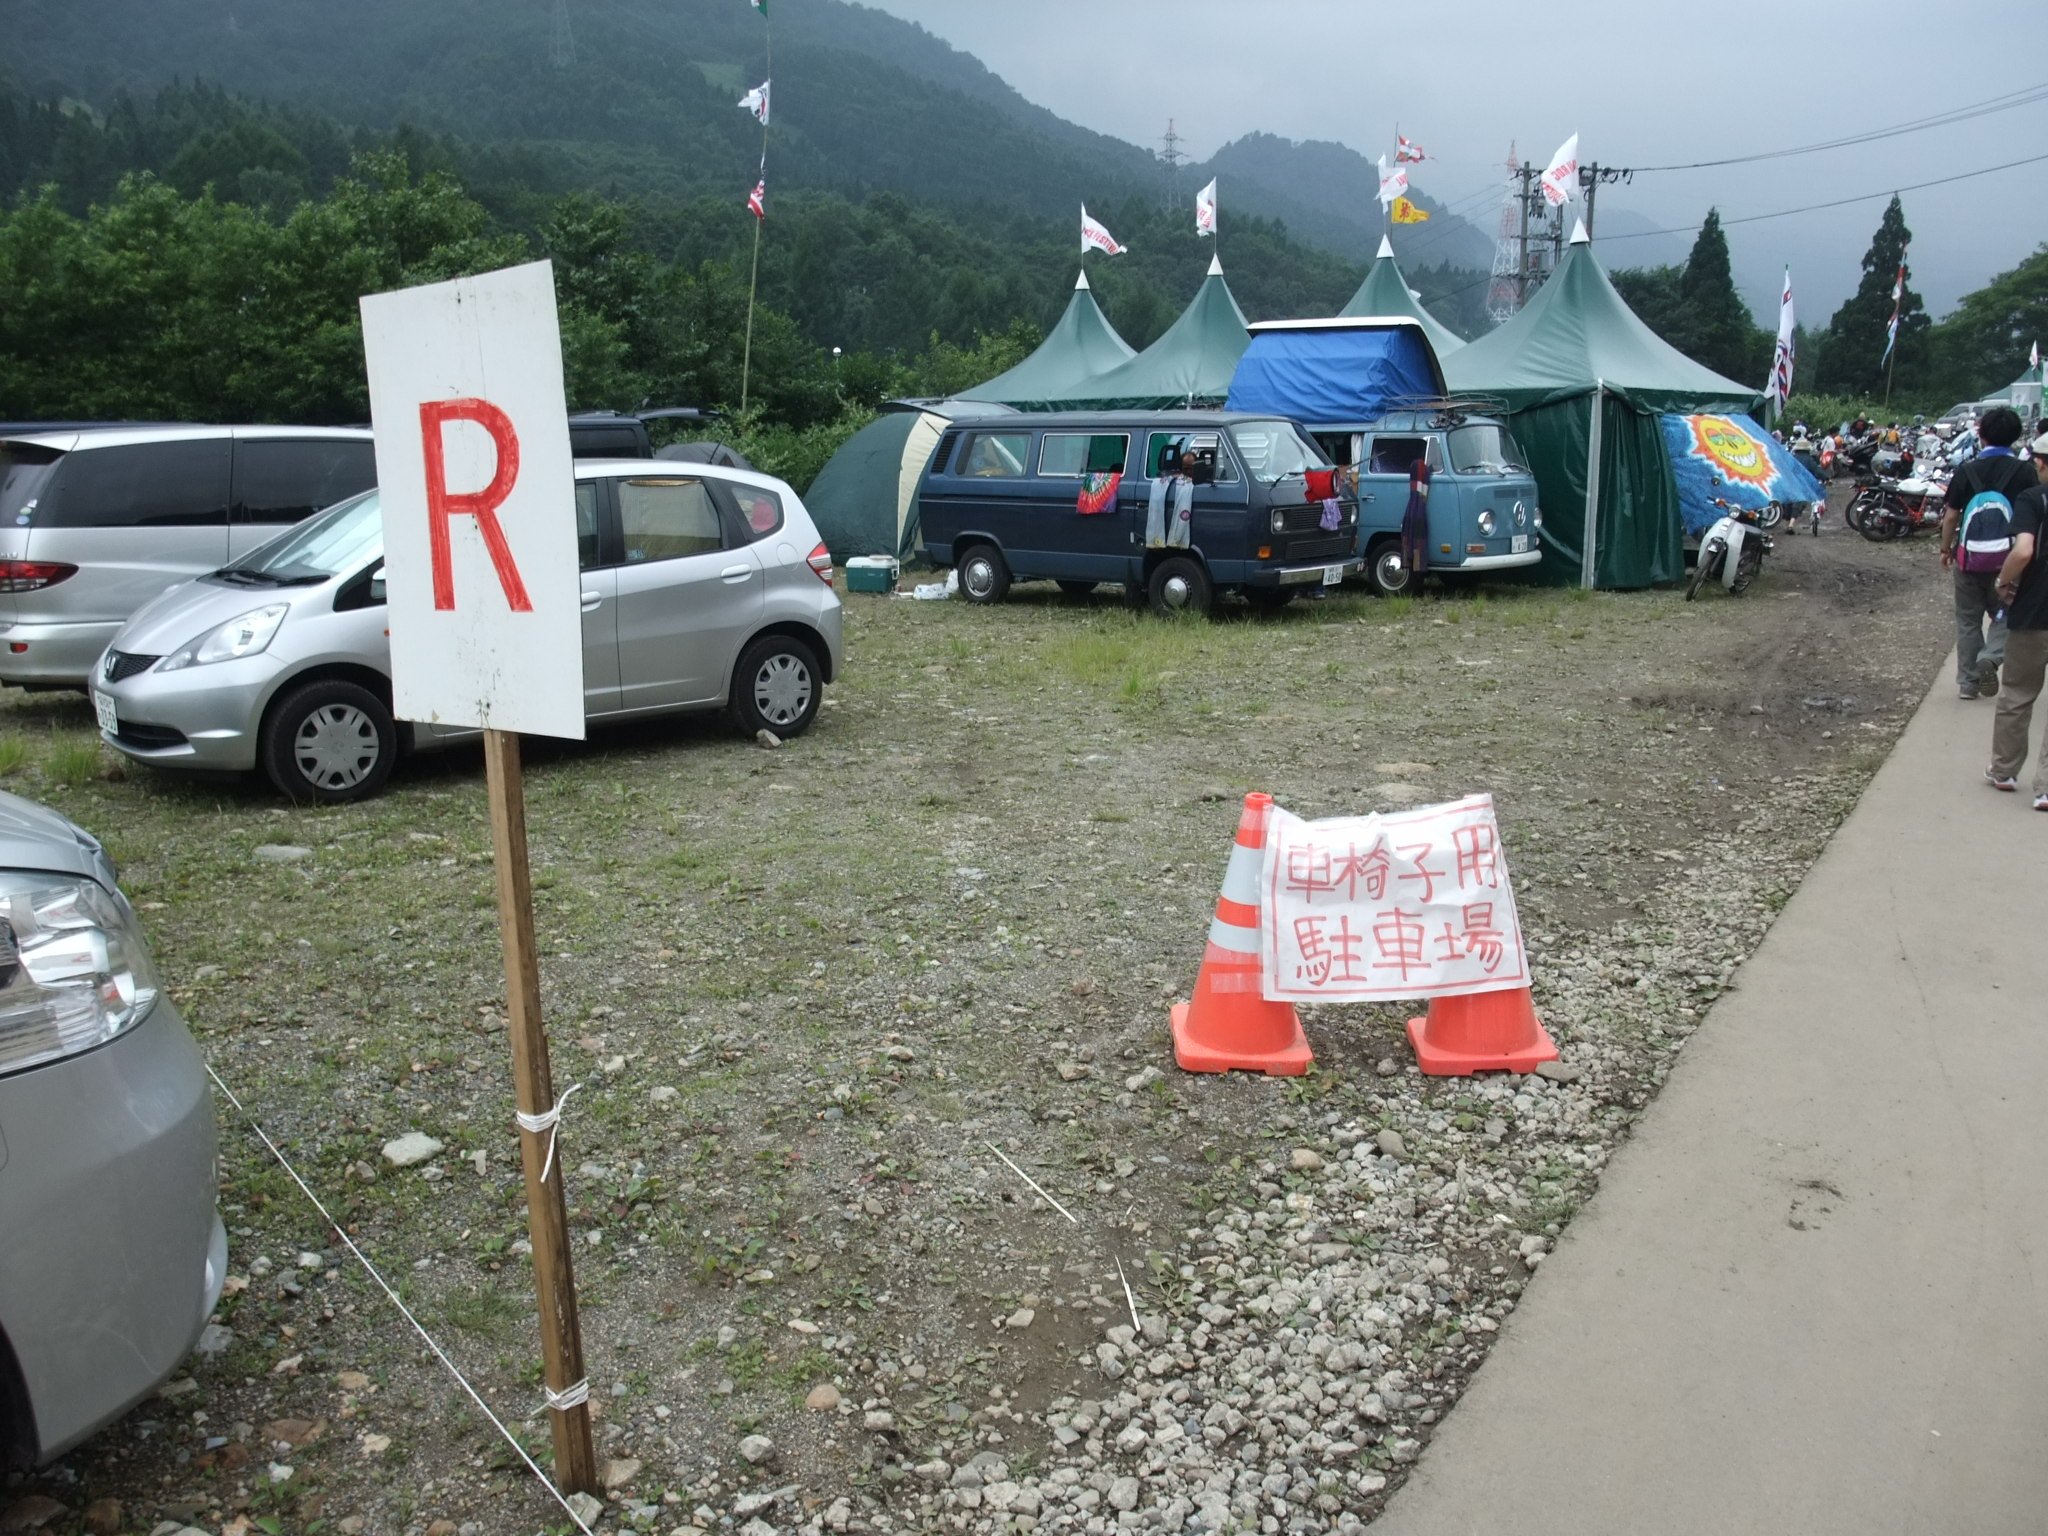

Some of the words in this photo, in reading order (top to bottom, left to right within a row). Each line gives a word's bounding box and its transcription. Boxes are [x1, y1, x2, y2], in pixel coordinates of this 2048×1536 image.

[419, 398, 534, 613] R
[1286, 825, 1498, 903] 車椅子用
[1293, 902, 1504, 987] 駐車場
